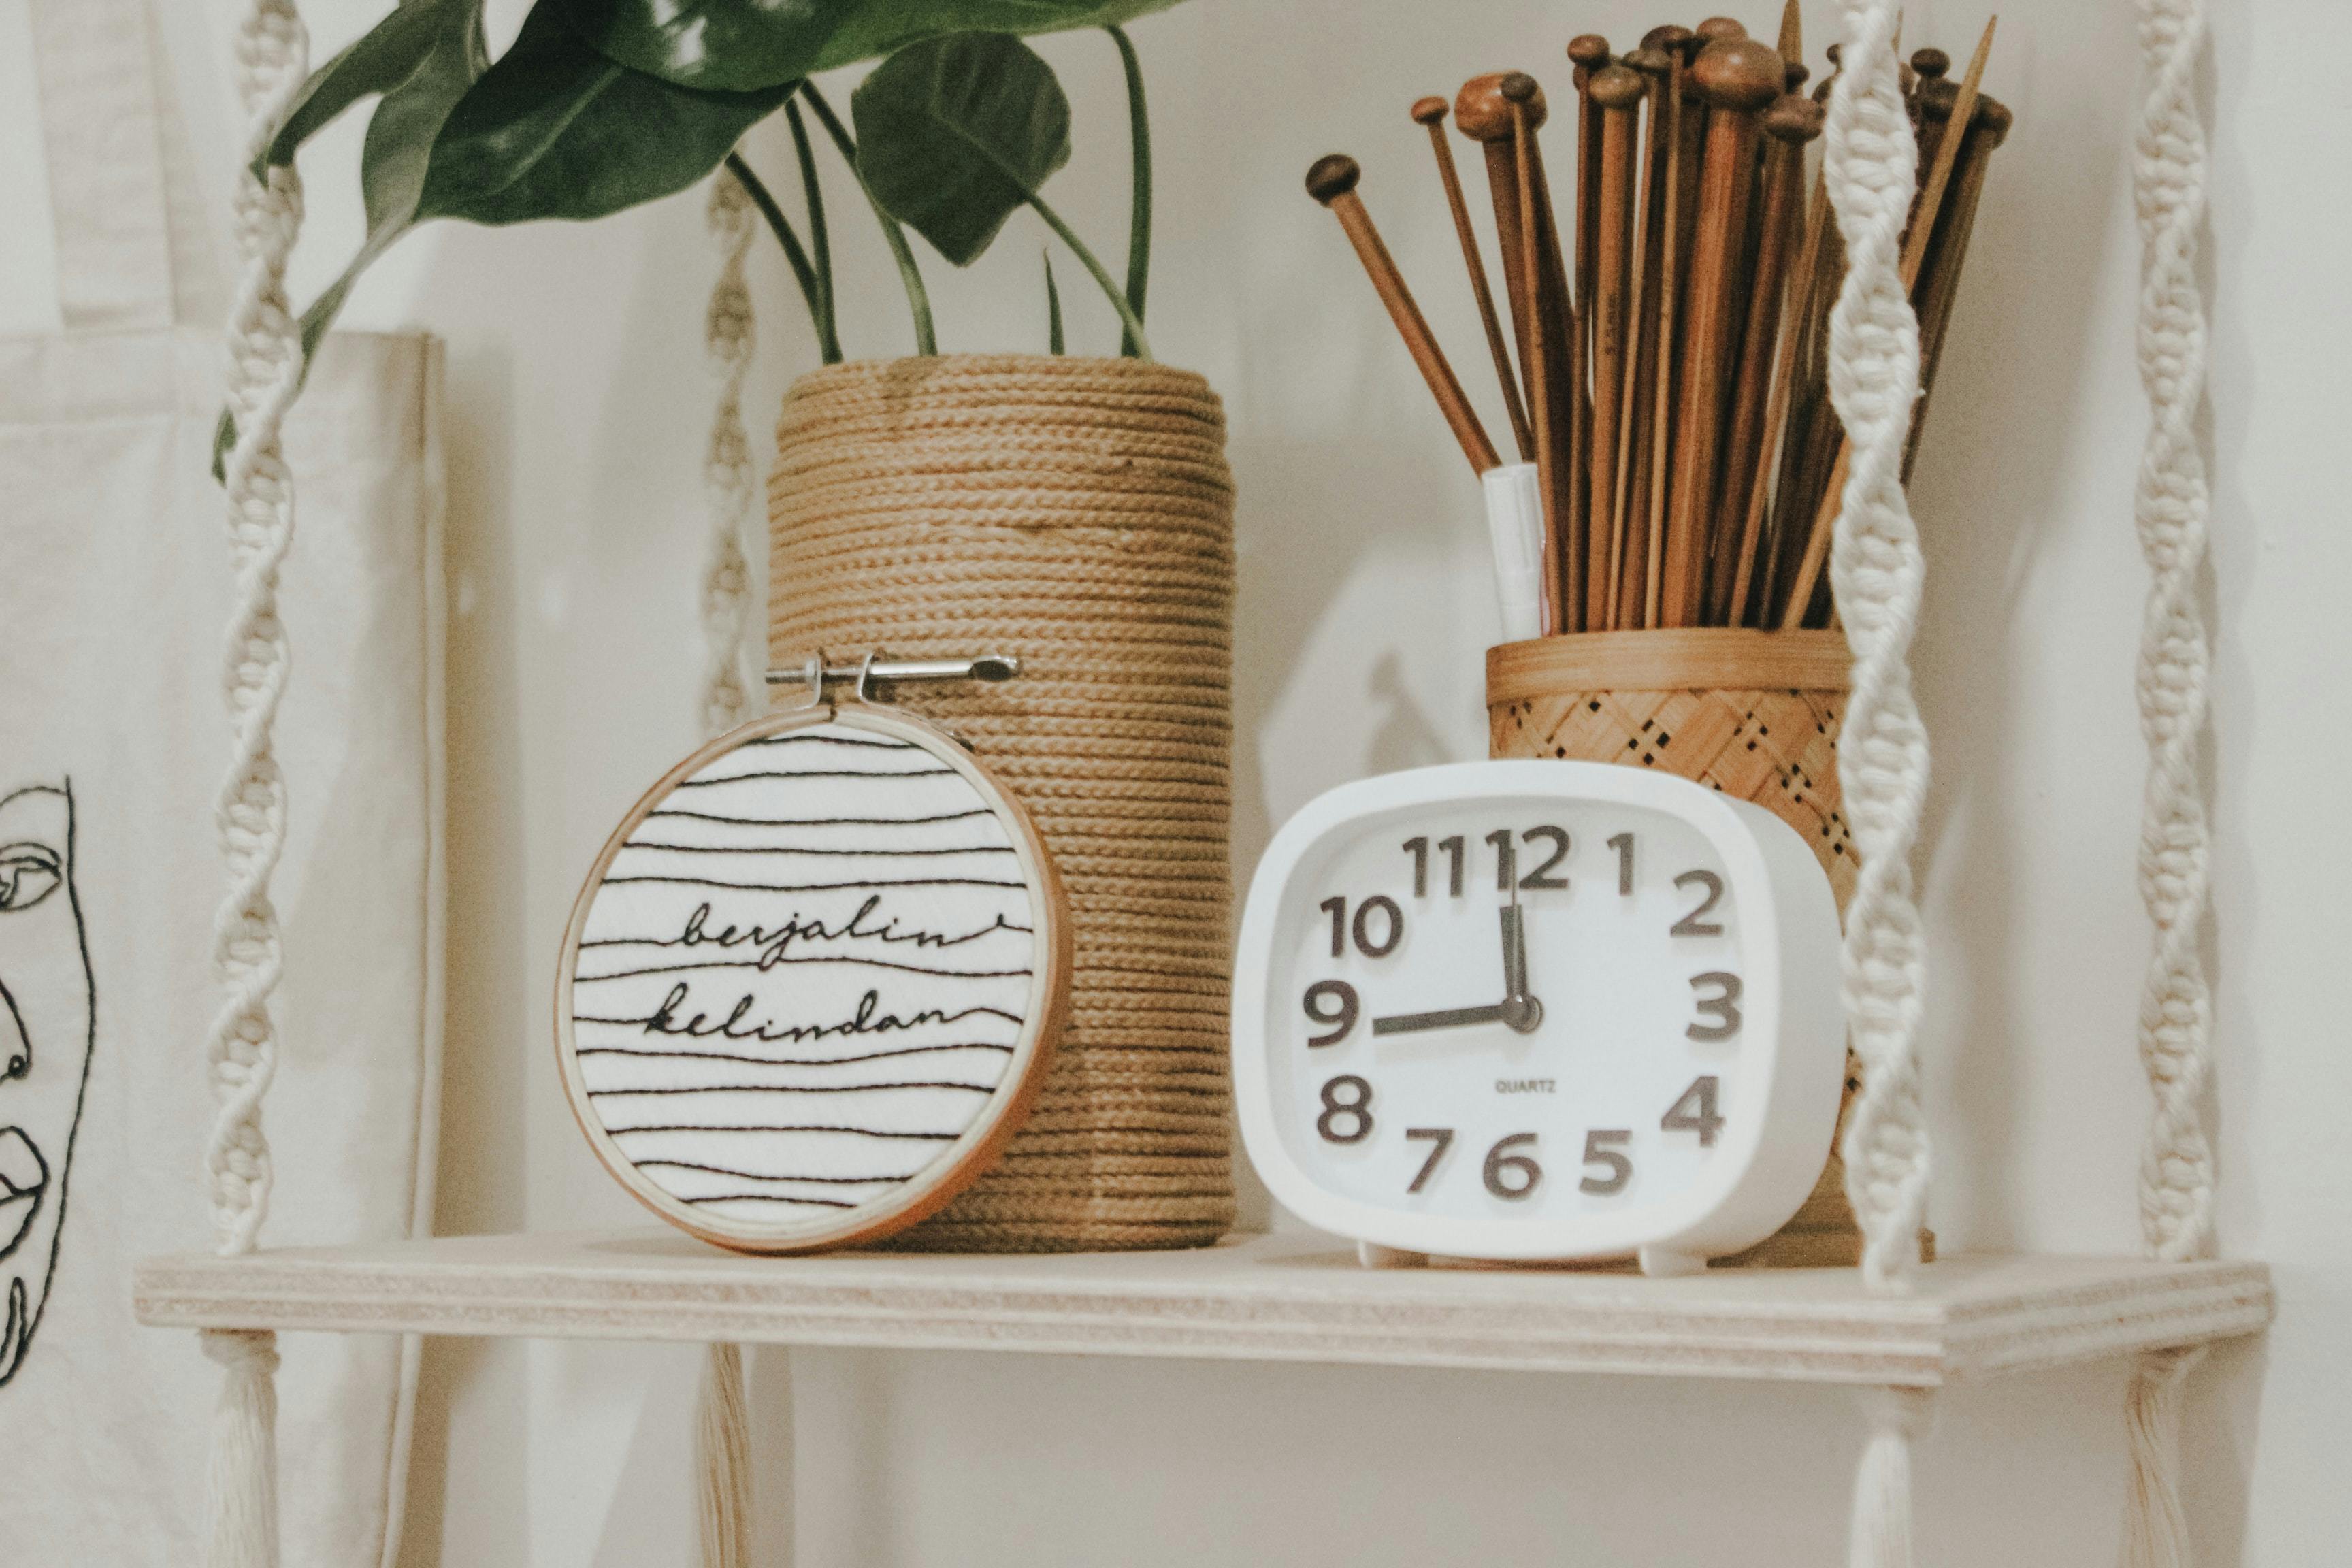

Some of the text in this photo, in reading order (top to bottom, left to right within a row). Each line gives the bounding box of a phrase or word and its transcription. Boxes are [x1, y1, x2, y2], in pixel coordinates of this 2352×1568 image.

[1402, 836, 1465, 898] 11
[1485, 825, 1571, 891] 12
[1607, 833, 1632, 896] 1
[681, 894, 955, 971] berjalin
[1320, 895, 1404, 958] 10
[1669, 870, 1725, 938] 2
[643, 983, 956, 1043] kelindan
[1303, 980, 1359, 1048] 9
[1685, 971, 1744, 1043] 3
[1316, 1075, 1374, 1145] 8
[1495, 1079, 1556, 1094] QUARTZ
[1661, 1075, 1726, 1148] 4
[1405, 1128, 1455, 1194] 7
[1482, 1133, 1542, 1202] 6
[1578, 1130, 1632, 1197] 5
